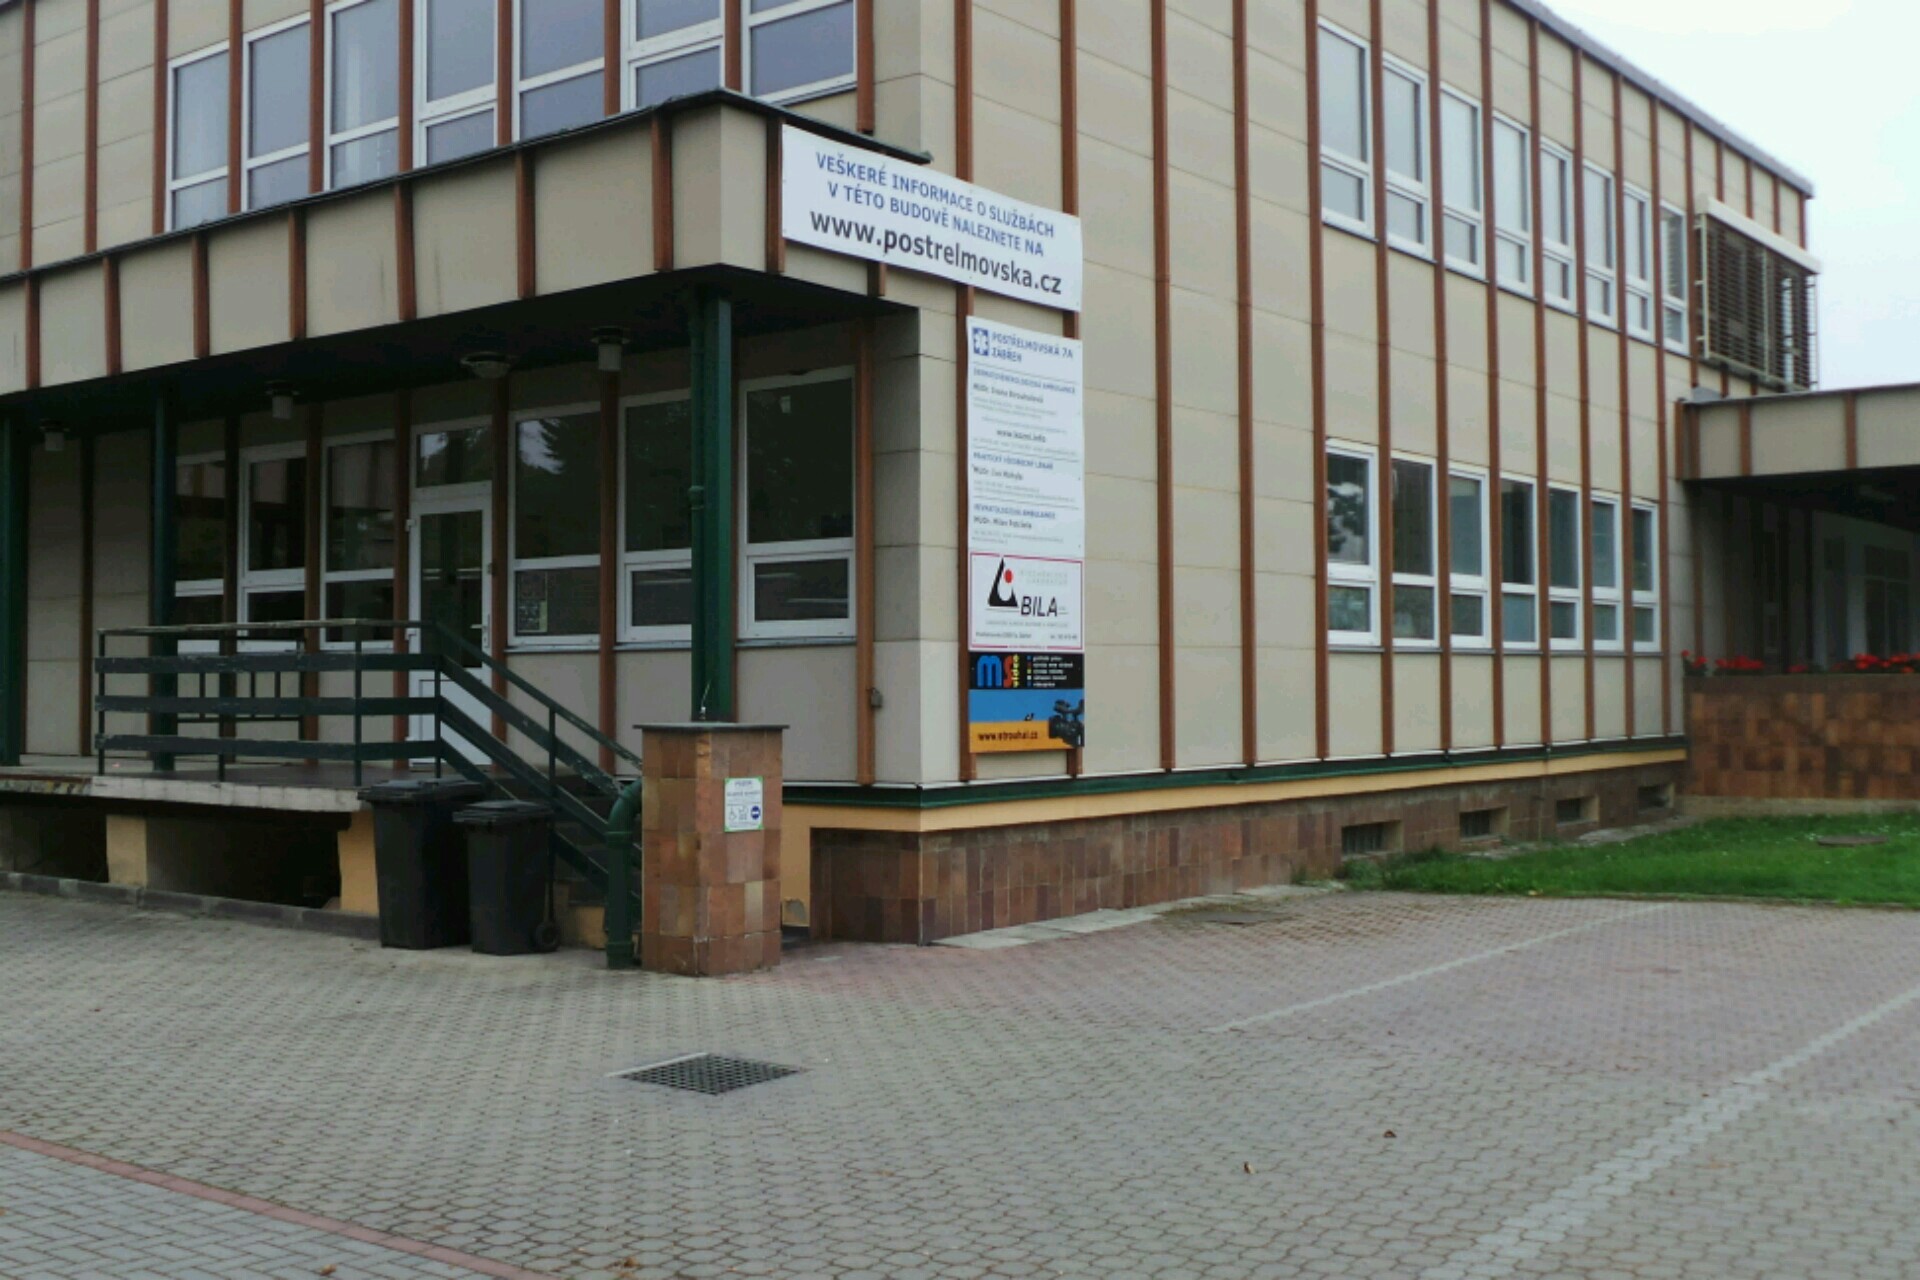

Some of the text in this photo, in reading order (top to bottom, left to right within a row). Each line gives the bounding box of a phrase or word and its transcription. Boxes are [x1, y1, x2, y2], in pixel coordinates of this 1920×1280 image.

[816, 151, 1055, 238] VEŠKERÉ INFORMACE O SLUŽBÁCH
[827, 181, 1044, 257] V TÉTO BUDOVĚ NALEZNETE NA
[810, 210, 1063, 295] www.postrelmovska.cz
[992, 332, 1059, 355] POSTŘELMOVSKÁ
[992, 347, 1022, 362] ZÁBŘEH
[1021, 596, 1058, 617] BILA
